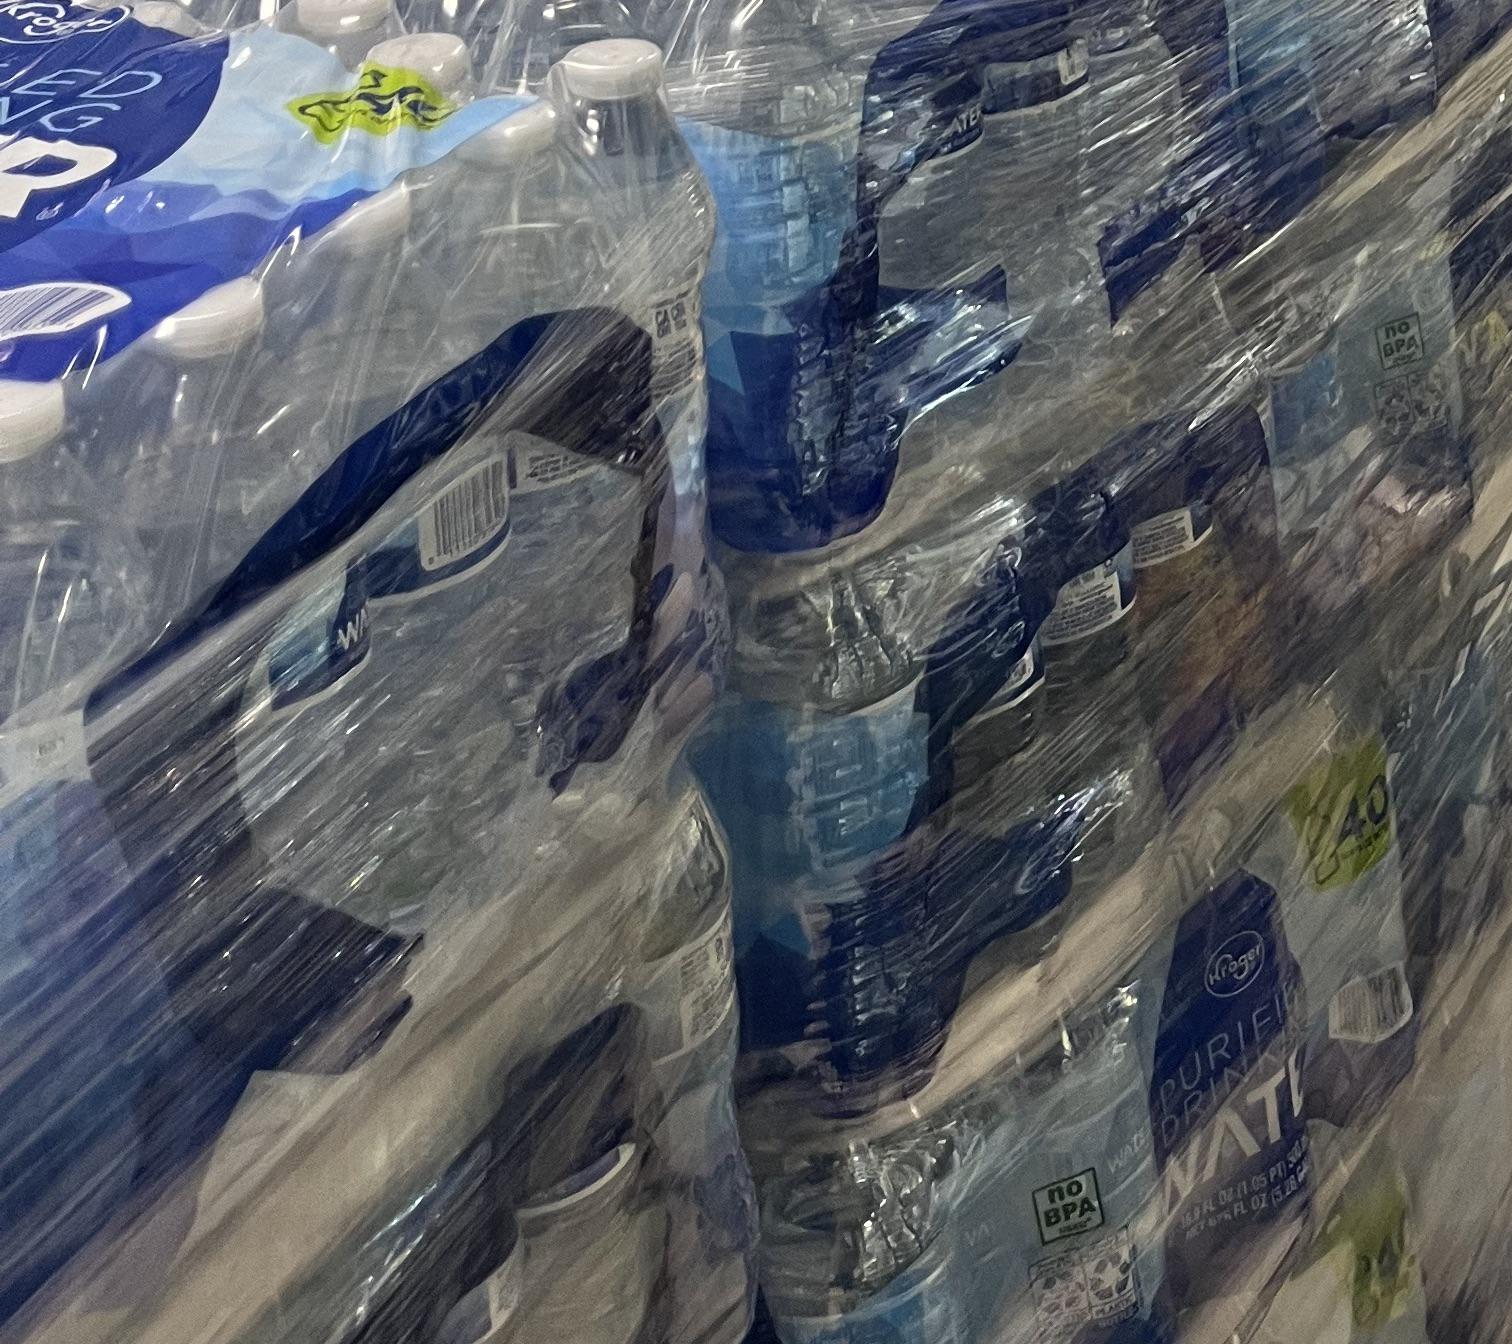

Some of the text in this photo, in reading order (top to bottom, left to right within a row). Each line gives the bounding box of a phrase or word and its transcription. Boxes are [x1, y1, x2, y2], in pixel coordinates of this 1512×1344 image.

[1208, 943, 1264, 987] Kroger
[1047, 1180, 1083, 1203] no
[1043, 1196, 1097, 1229] BPA
